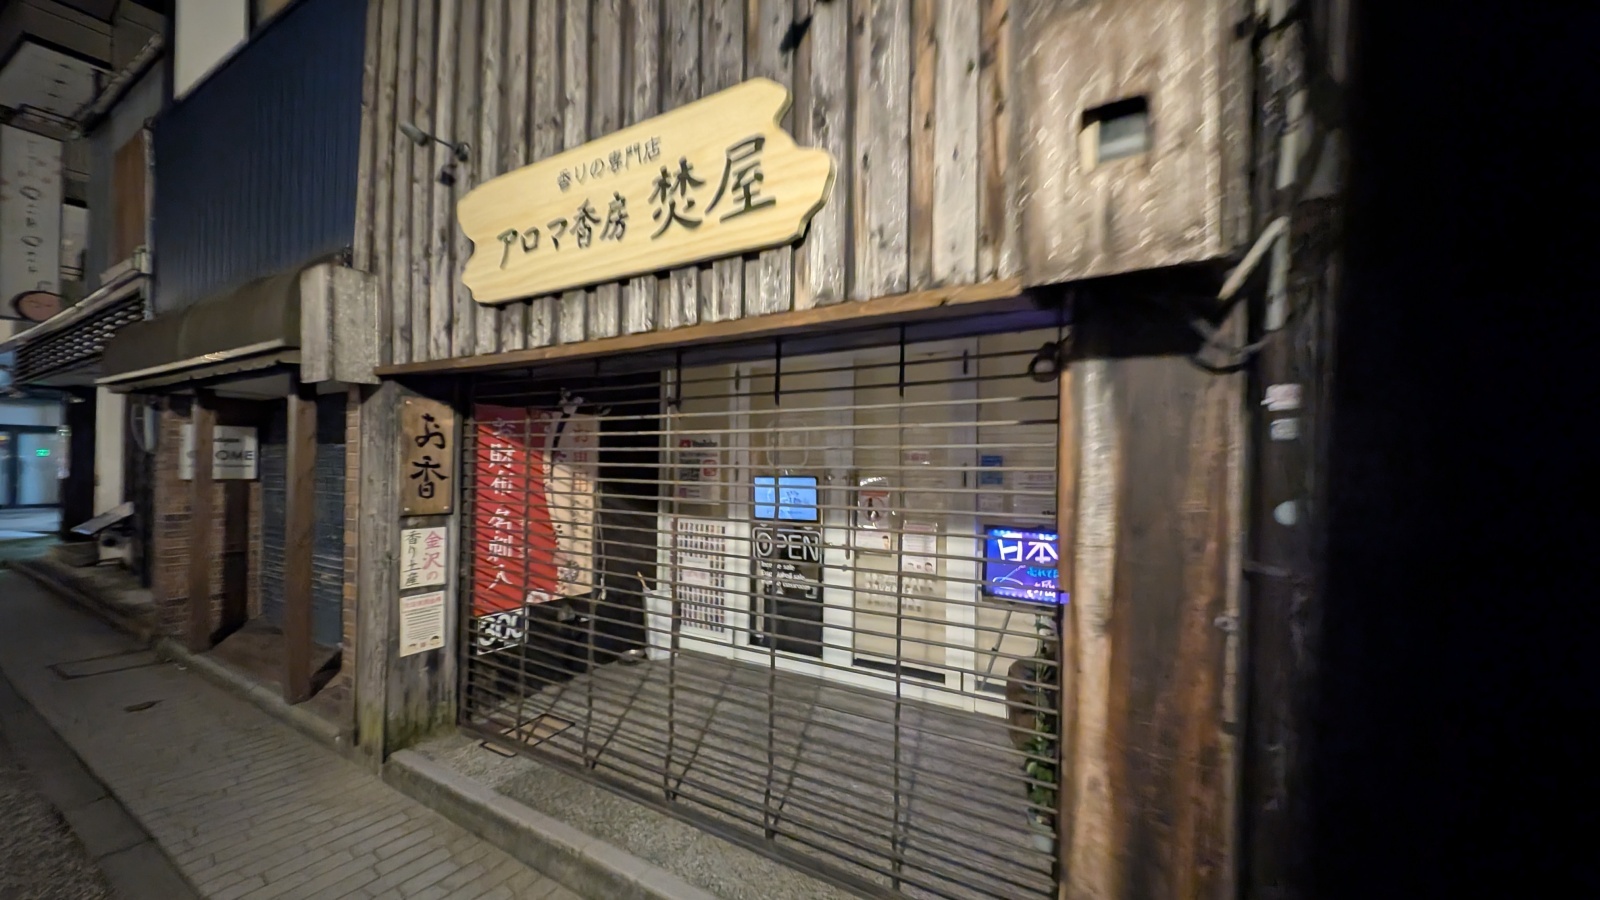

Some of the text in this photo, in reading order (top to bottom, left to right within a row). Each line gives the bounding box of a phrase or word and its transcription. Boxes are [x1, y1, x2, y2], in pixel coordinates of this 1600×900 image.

[557, 136, 661, 193] 香りの専門店
[497, 134, 776, 269] アロマ香房 焚屋
[410, 413, 448, 499] お香
[403, 530, 421, 587] 香り土産
[423, 530, 445, 581] 金沢の
[756, 532, 819, 561] OPEN
